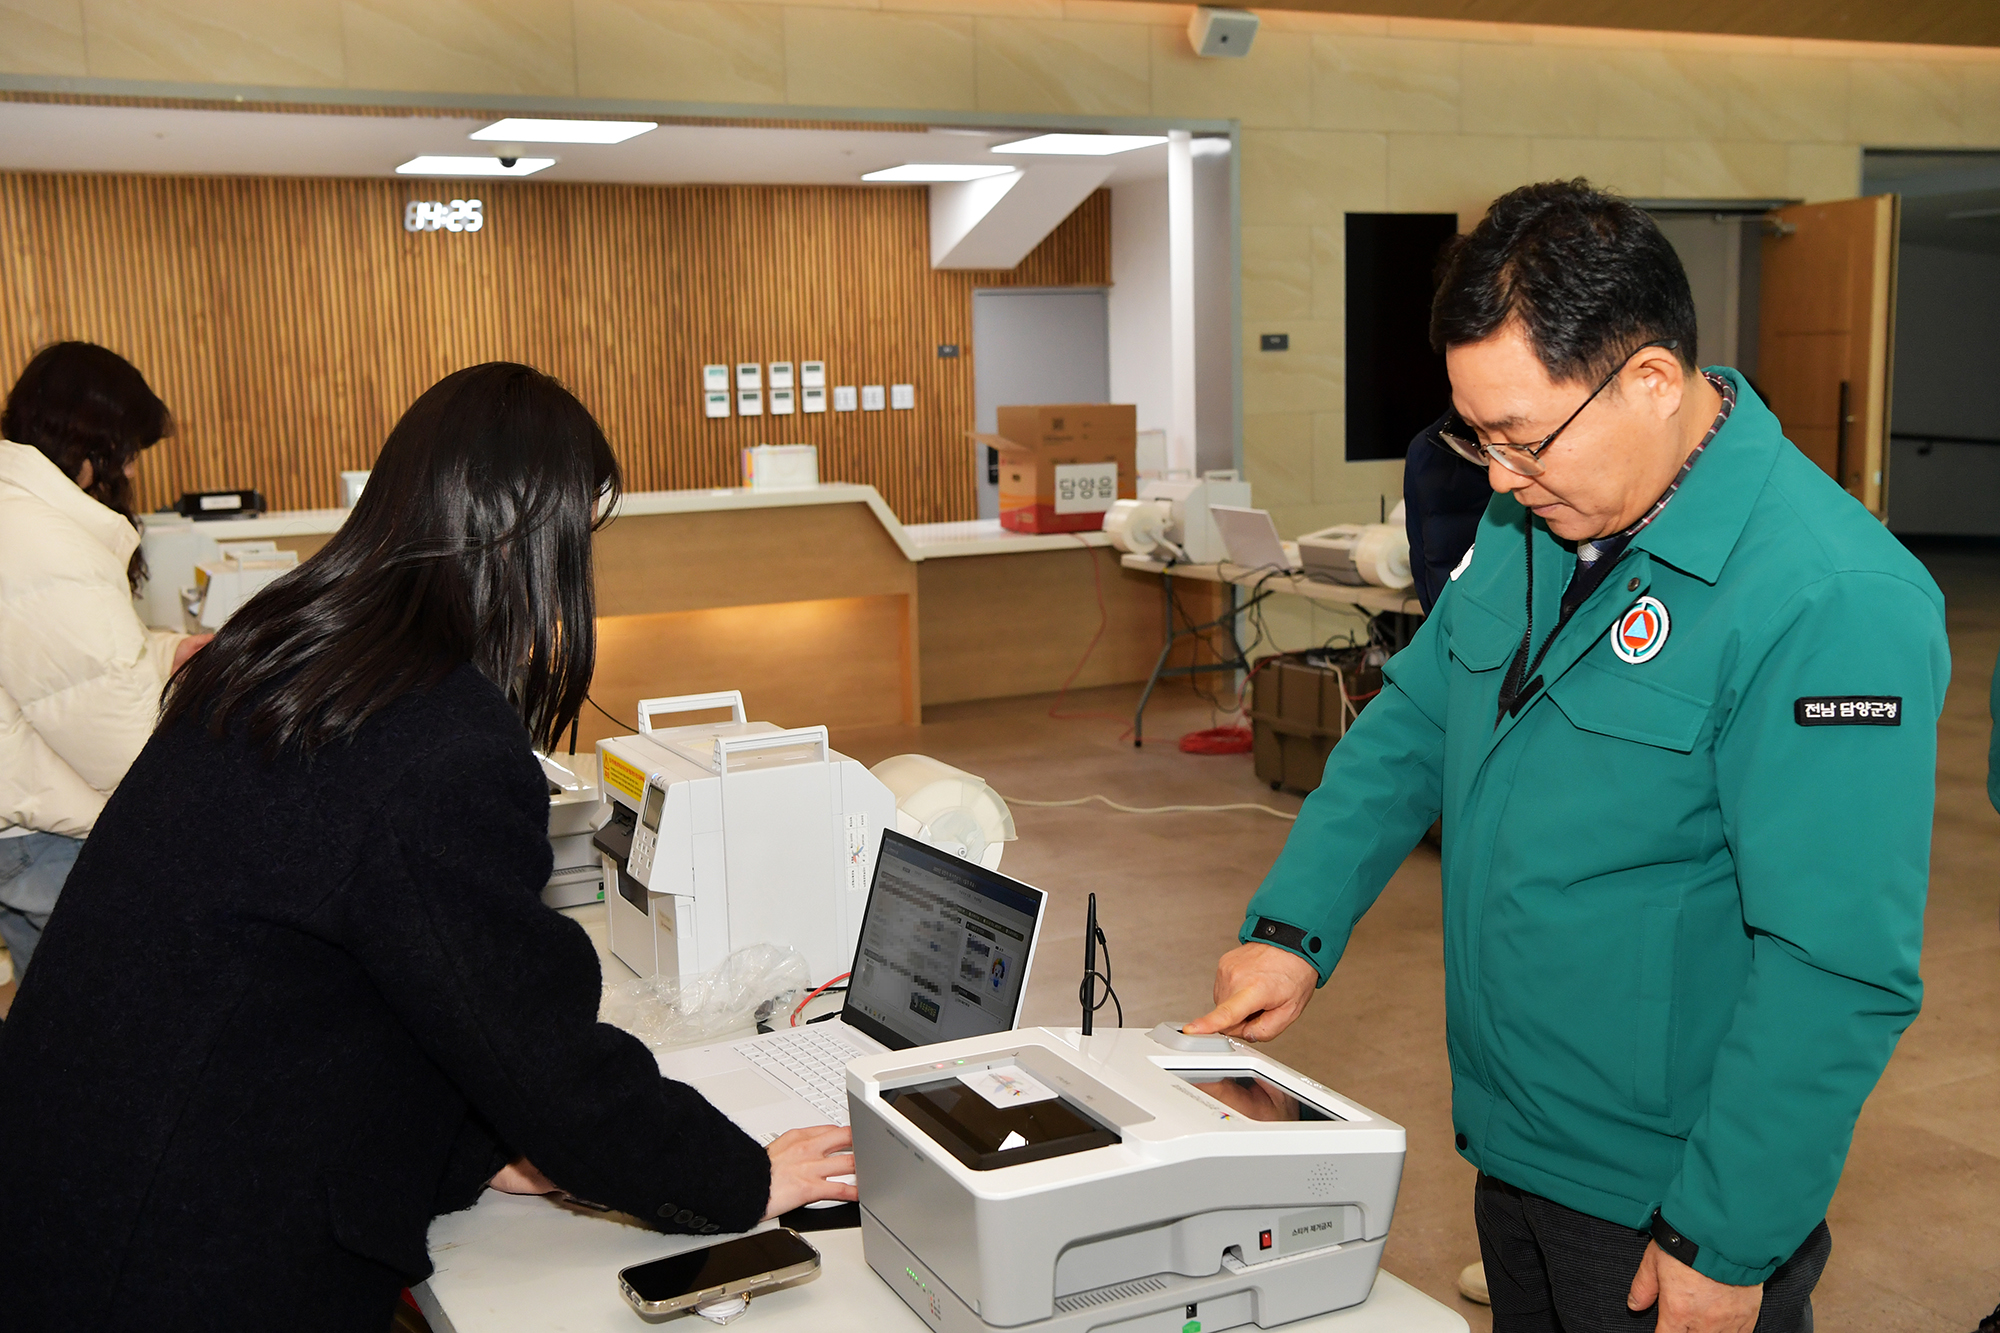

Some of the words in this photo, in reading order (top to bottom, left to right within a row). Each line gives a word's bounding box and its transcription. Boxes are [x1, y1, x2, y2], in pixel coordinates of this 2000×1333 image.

[415, 199, 483, 232] 14:25
[1059, 476, 1112, 500] 담양읍
[1804, 702, 1837, 718] 전남
[1839, 701, 1897, 719] 담양군청
[1291, 1226, 1309, 1236] 스티커
[1310, 1220, 1333, 1232] 제거금지
